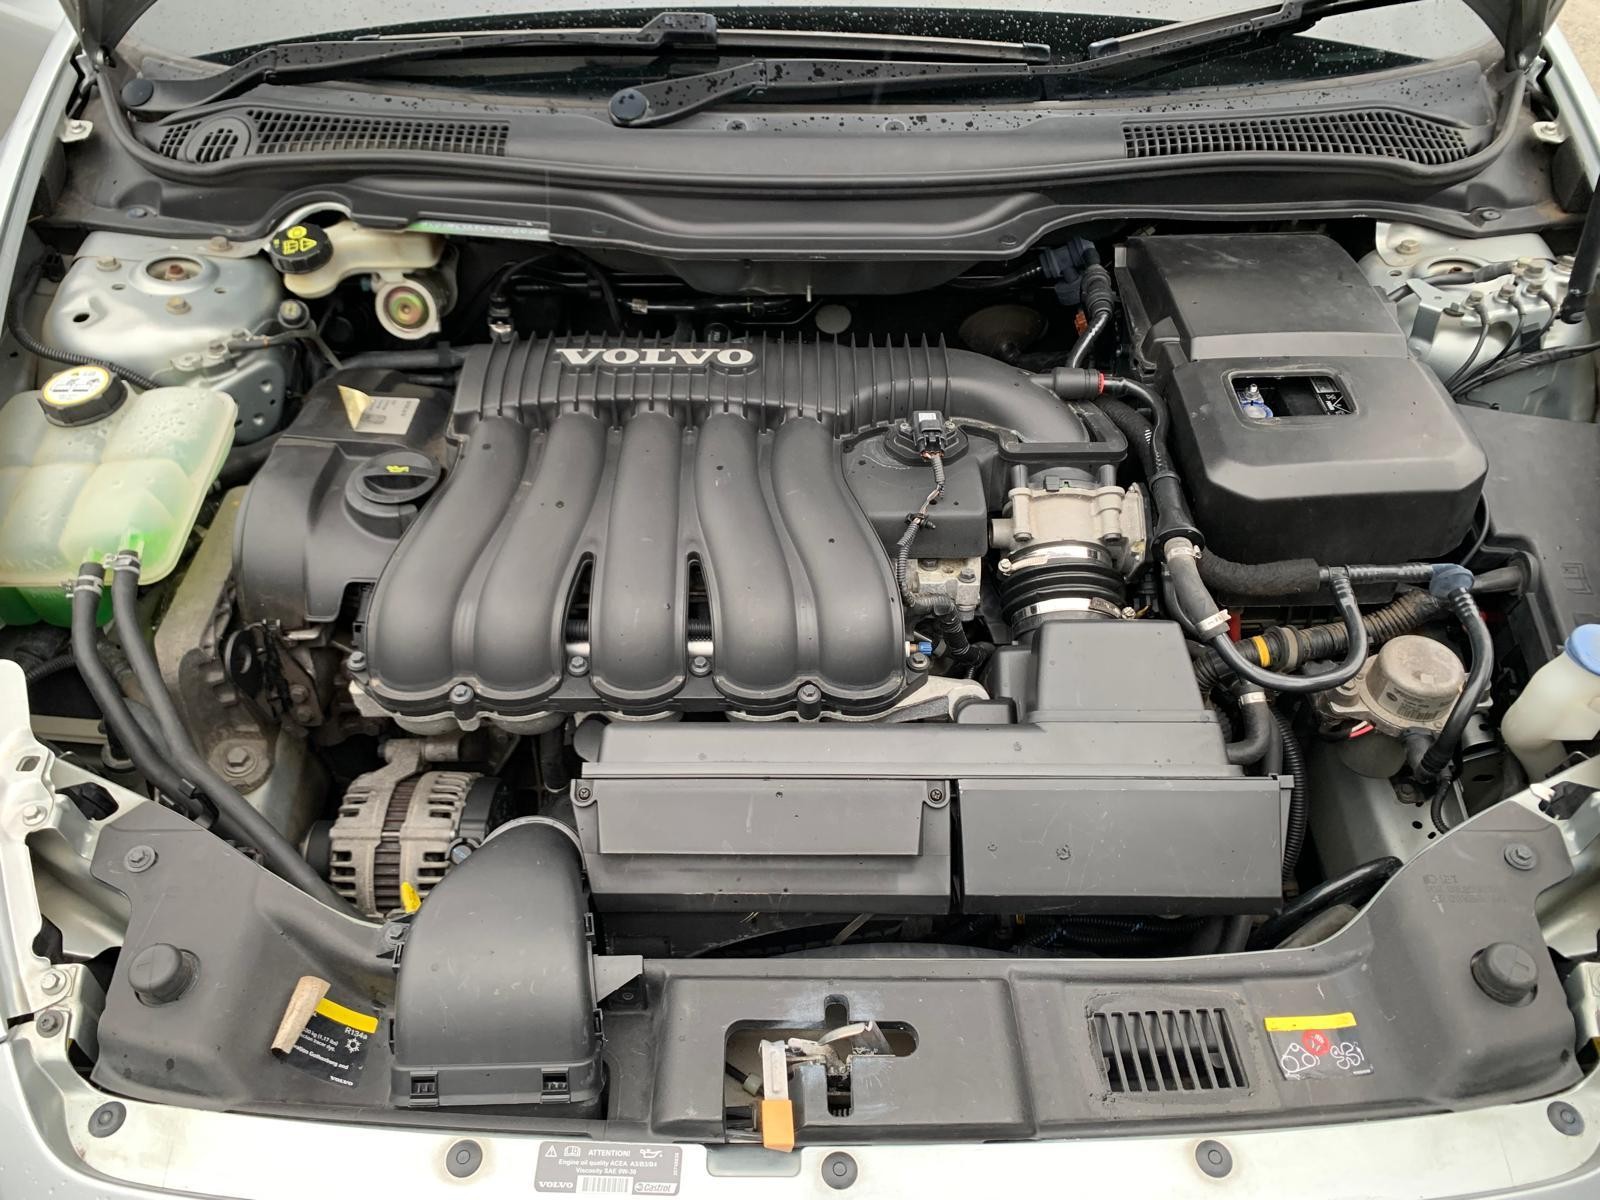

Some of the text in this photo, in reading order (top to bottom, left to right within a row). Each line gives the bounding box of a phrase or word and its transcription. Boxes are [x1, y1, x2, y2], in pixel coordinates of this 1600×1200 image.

[555, 348, 754, 365] VOLVO
[344, 1026, 368, 1040] R134a
[329, 1075, 354, 1087] VOLVO
[588, 1149, 631, 1158] ATTENTION!
[558, 1158, 579, 1167] Engine
[589, 1160, 609, 1168] quality
[576, 1167, 603, 1175] Viscosity
[537, 1181, 574, 1189] VOLVO
[643, 1183, 672, 1192] Castrol
